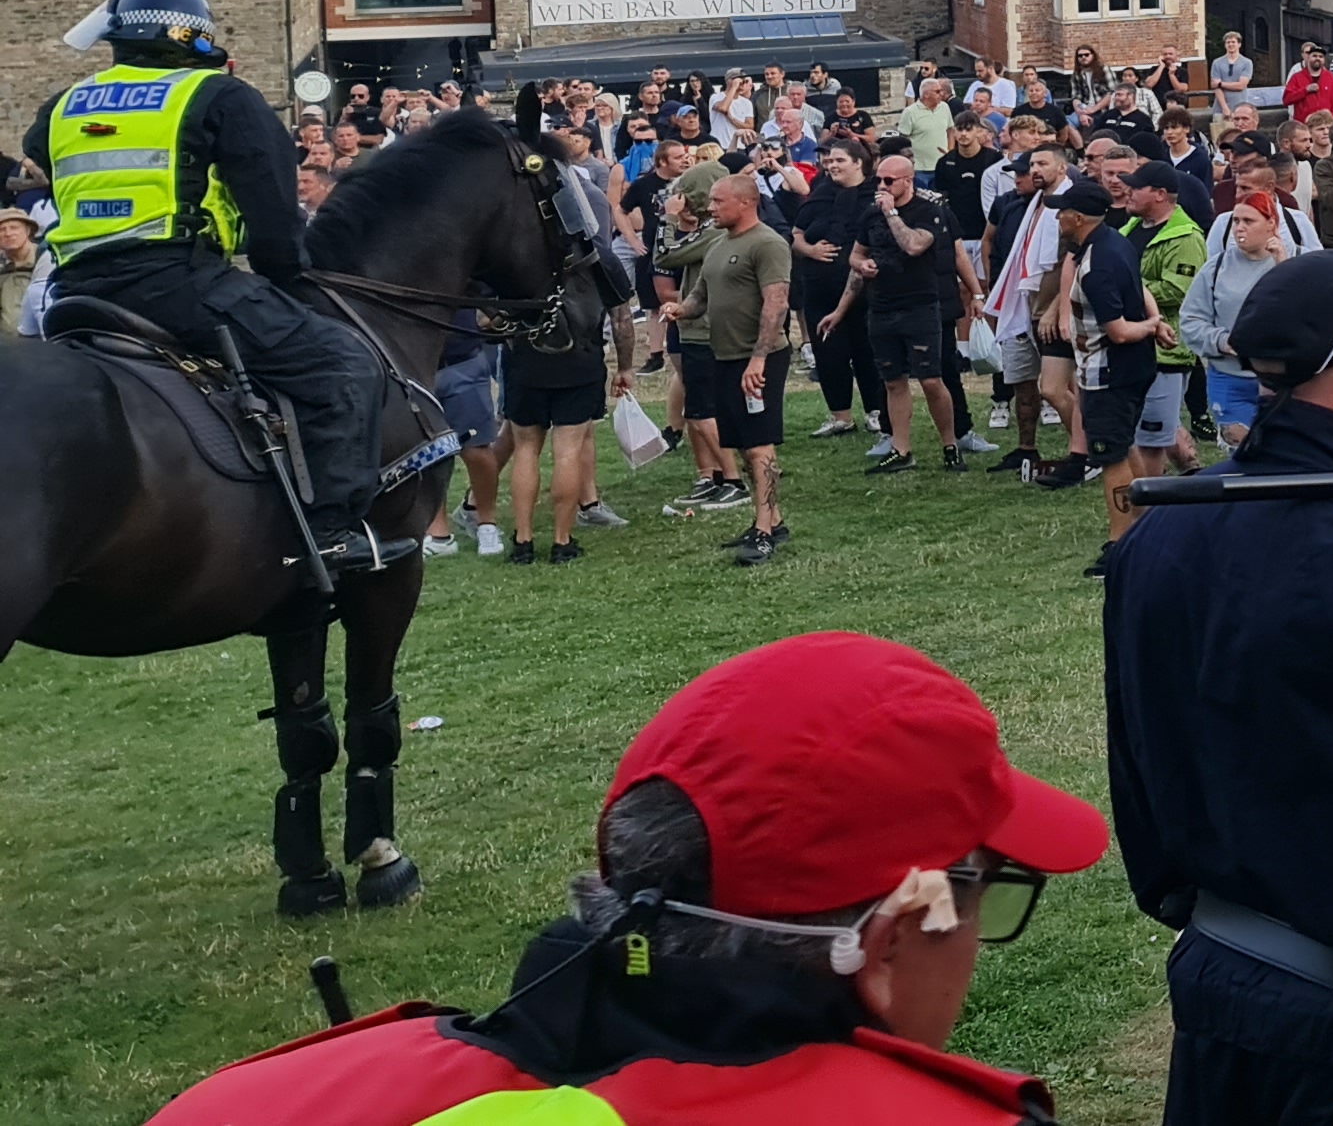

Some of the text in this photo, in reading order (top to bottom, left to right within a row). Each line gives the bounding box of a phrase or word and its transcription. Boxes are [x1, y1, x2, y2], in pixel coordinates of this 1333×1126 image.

[537, 2, 615, 23] WINE
[626, 0, 679, 19] BAR
[67, 84, 167, 112] POLICE
[79, 200, 132, 216] POLICE
